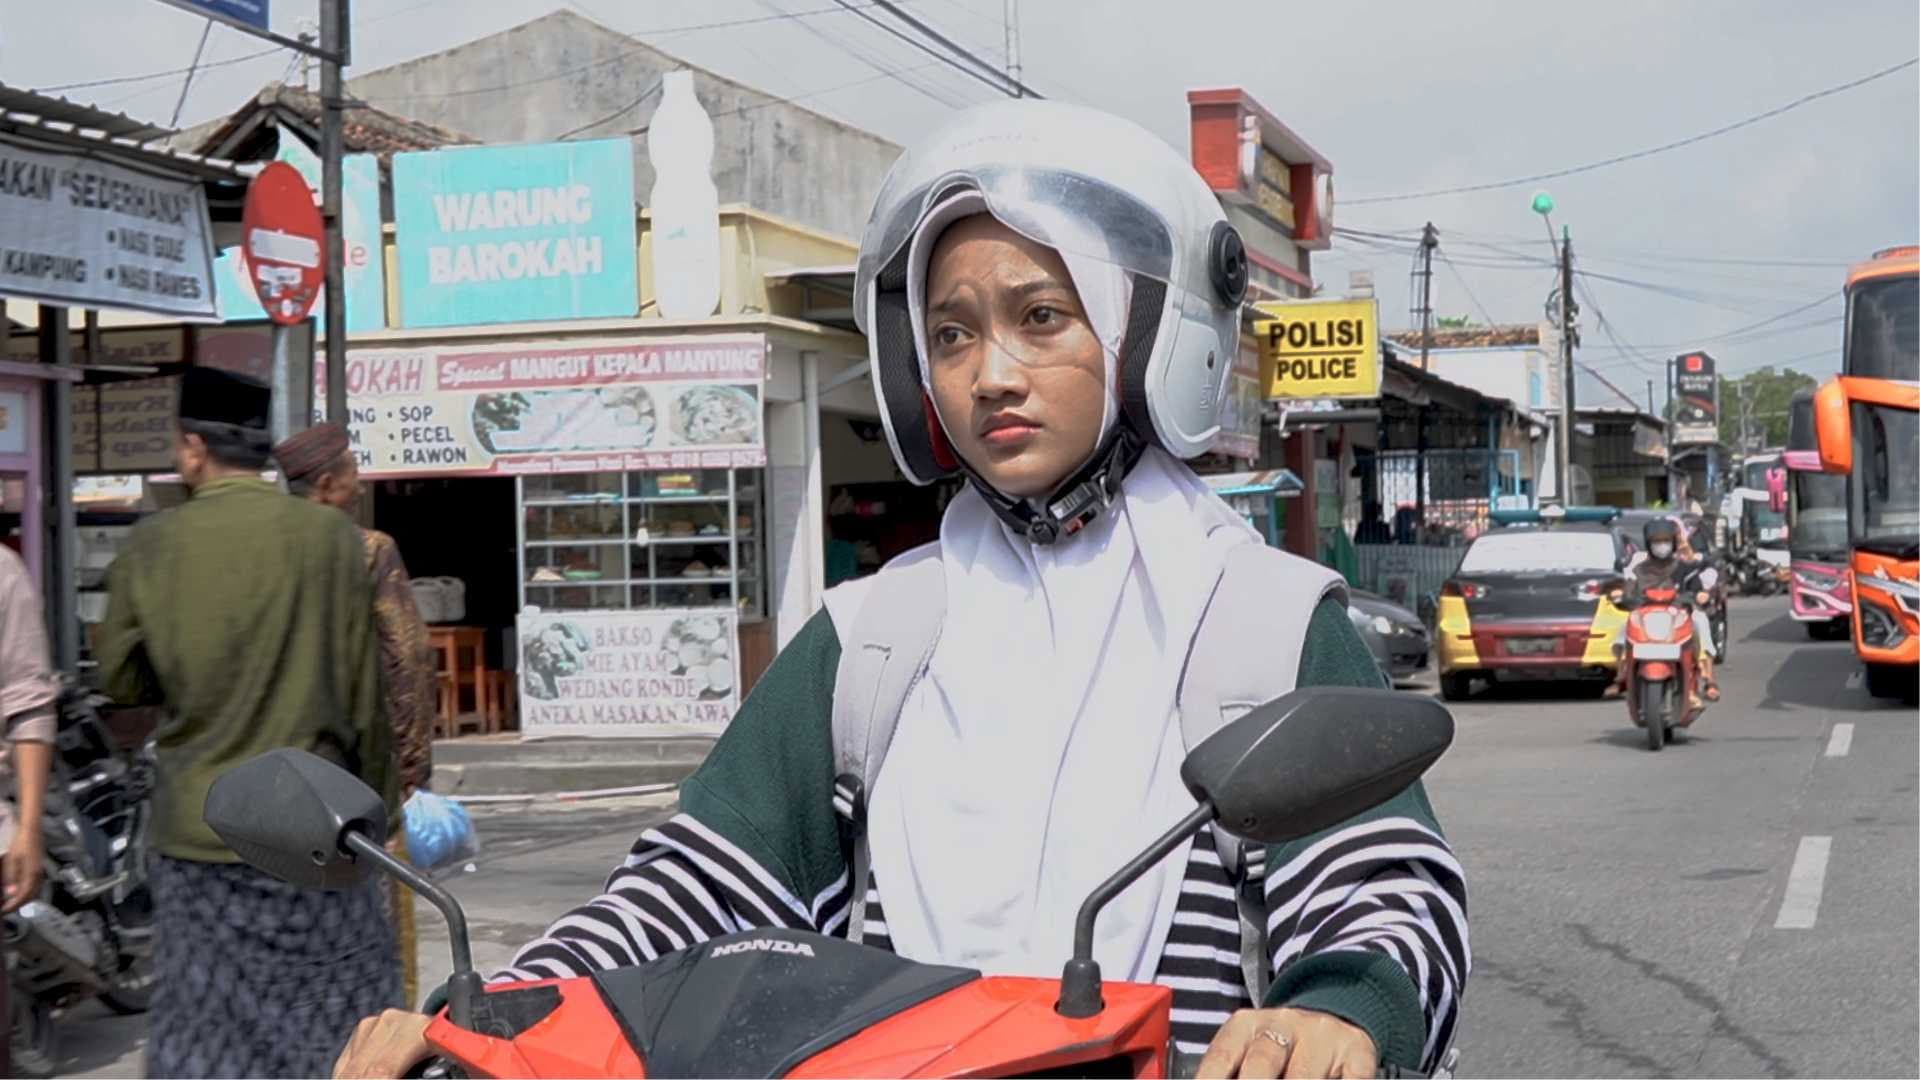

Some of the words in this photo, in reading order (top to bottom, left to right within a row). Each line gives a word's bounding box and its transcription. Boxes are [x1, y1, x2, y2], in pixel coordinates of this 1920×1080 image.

[432, 184, 594, 233] WARUNG
[6, 251, 88, 284] KAMPUNG
[427, 236, 604, 284] BAROKAH
[118, 264, 150, 291] NASI
[1269, 319, 1364, 348] POLISI
[439, 359, 505, 387] Special
[510, 356, 589, 380] MANGUT
[594, 351, 662, 377] KEPALA
[1277, 357, 1357, 381] POLICE
[399, 406, 433, 422] SOP
[401, 426, 455, 444] PECEL
[403, 447, 468, 465] RAWON
[595, 627, 652, 647] BAKSO
[585, 653, 614, 673] MIE
[621, 652, 669, 673] AYAM
[559, 679, 634, 699] WEDANG
[637, 677, 697, 698] RONDE
[528, 705, 587, 725] ANEKA
[591, 704, 678, 724] MASAKAN
[710, 939, 816, 958] HONDA
